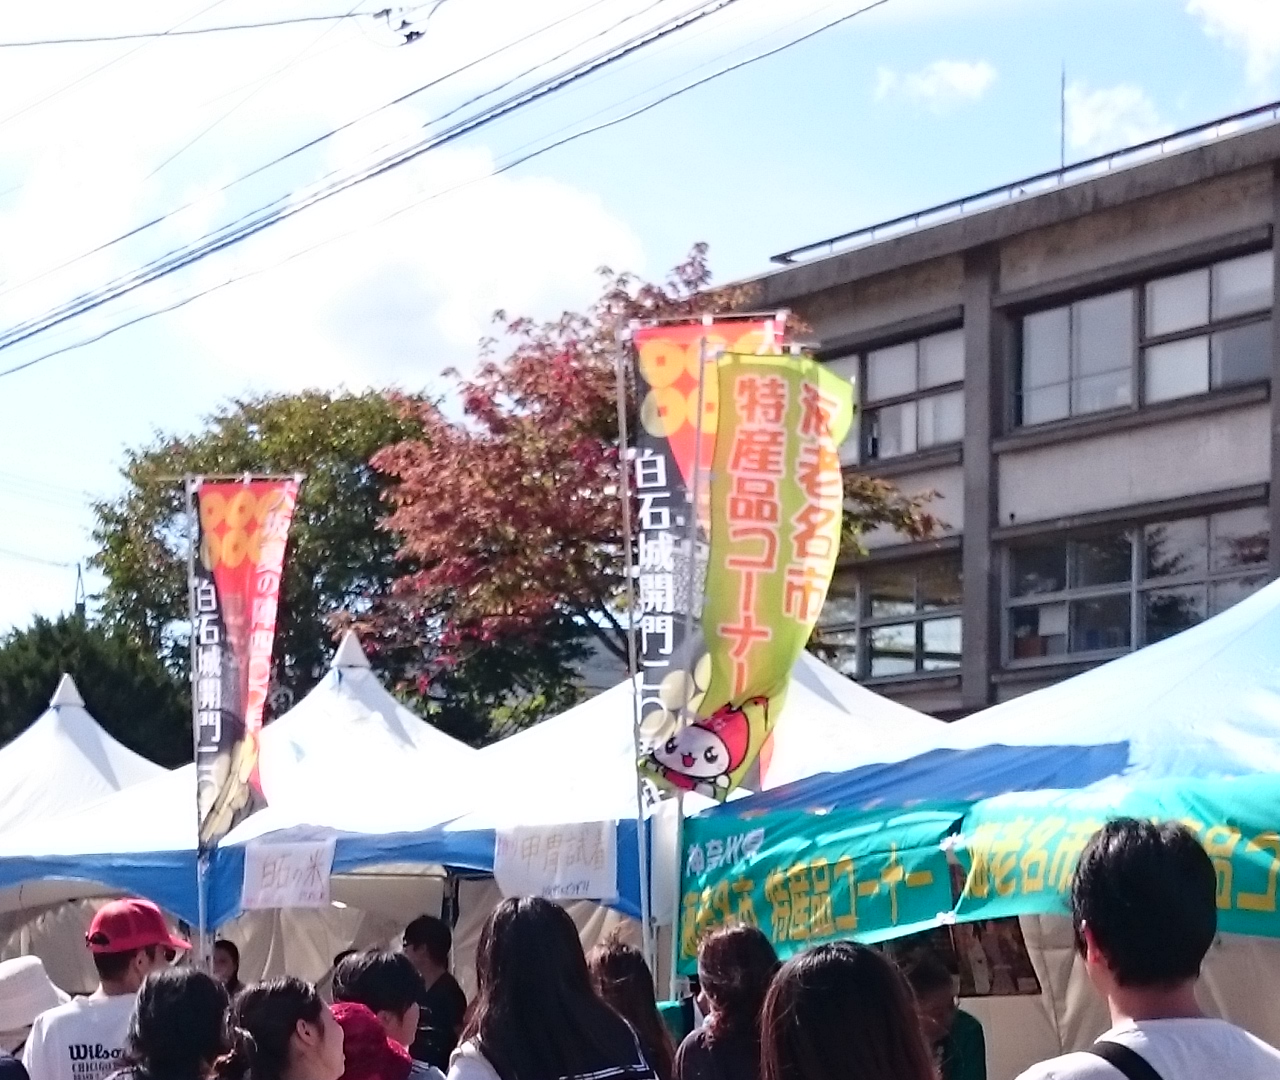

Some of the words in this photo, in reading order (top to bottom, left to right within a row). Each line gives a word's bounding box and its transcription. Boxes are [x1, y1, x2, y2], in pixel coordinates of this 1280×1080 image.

[718, 374, 789, 699] 特産品コーナー
[782, 381, 841, 624] 海老名市
